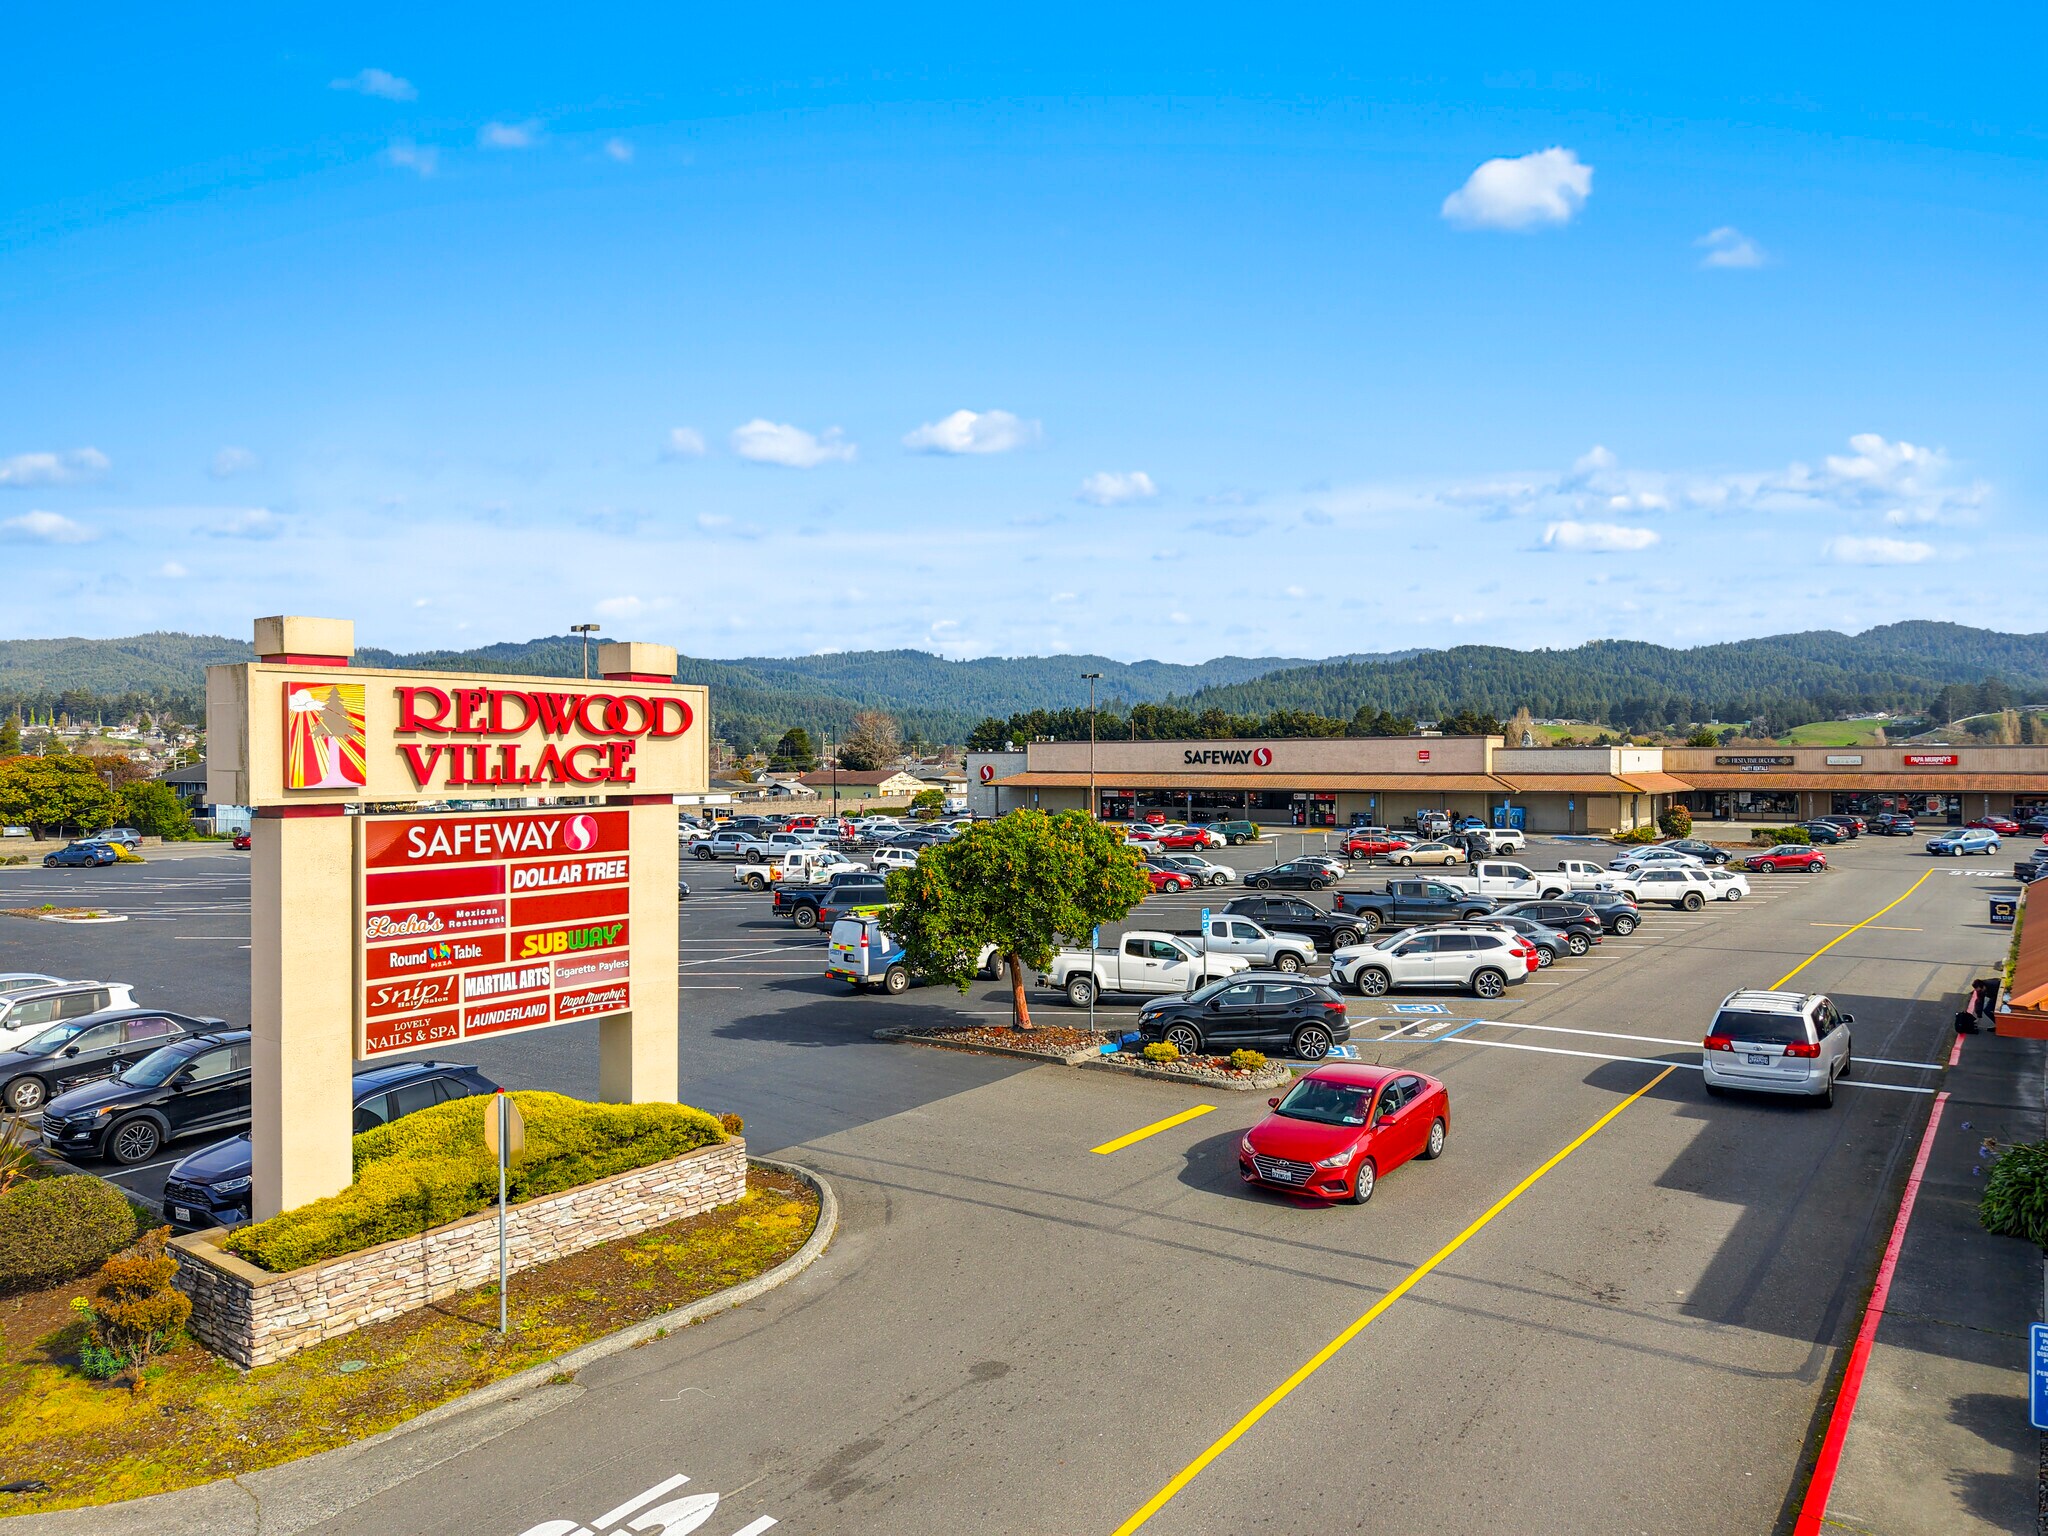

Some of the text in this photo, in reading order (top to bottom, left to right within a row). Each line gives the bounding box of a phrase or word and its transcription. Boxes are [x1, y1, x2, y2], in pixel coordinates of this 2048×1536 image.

[396, 686, 694, 737] REDWOOD
[397, 739, 636, 786] VILLAGE
[1184, 750, 1253, 764] SAFEWAY
[407, 820, 561, 859] SAFEWAY
[513, 860, 628, 889] DOLLAR TREE
[366, 911, 444, 938] Locha's
[448, 916, 505, 928] Restaurant
[456, 908, 498, 918] Mexican
[520, 923, 624, 958] SUBWAY
[389, 943, 482, 968] Round Table
[430, 960, 453, 968] PIZZA
[556, 959, 629, 979] Cigarette Payless
[465, 967, 550, 998] MARTIAL ARTS
[397, 996, 449, 1008] Hair Salon
[559, 987, 627, 1009] Papa Murphy's
[572, 1003, 614, 1015] PIZZA
[394, 1018, 432, 1031] LOVELY
[466, 1003, 547, 1029] LAUNDERLAND
[366, 1024, 457, 1051] NAILS & SPA
